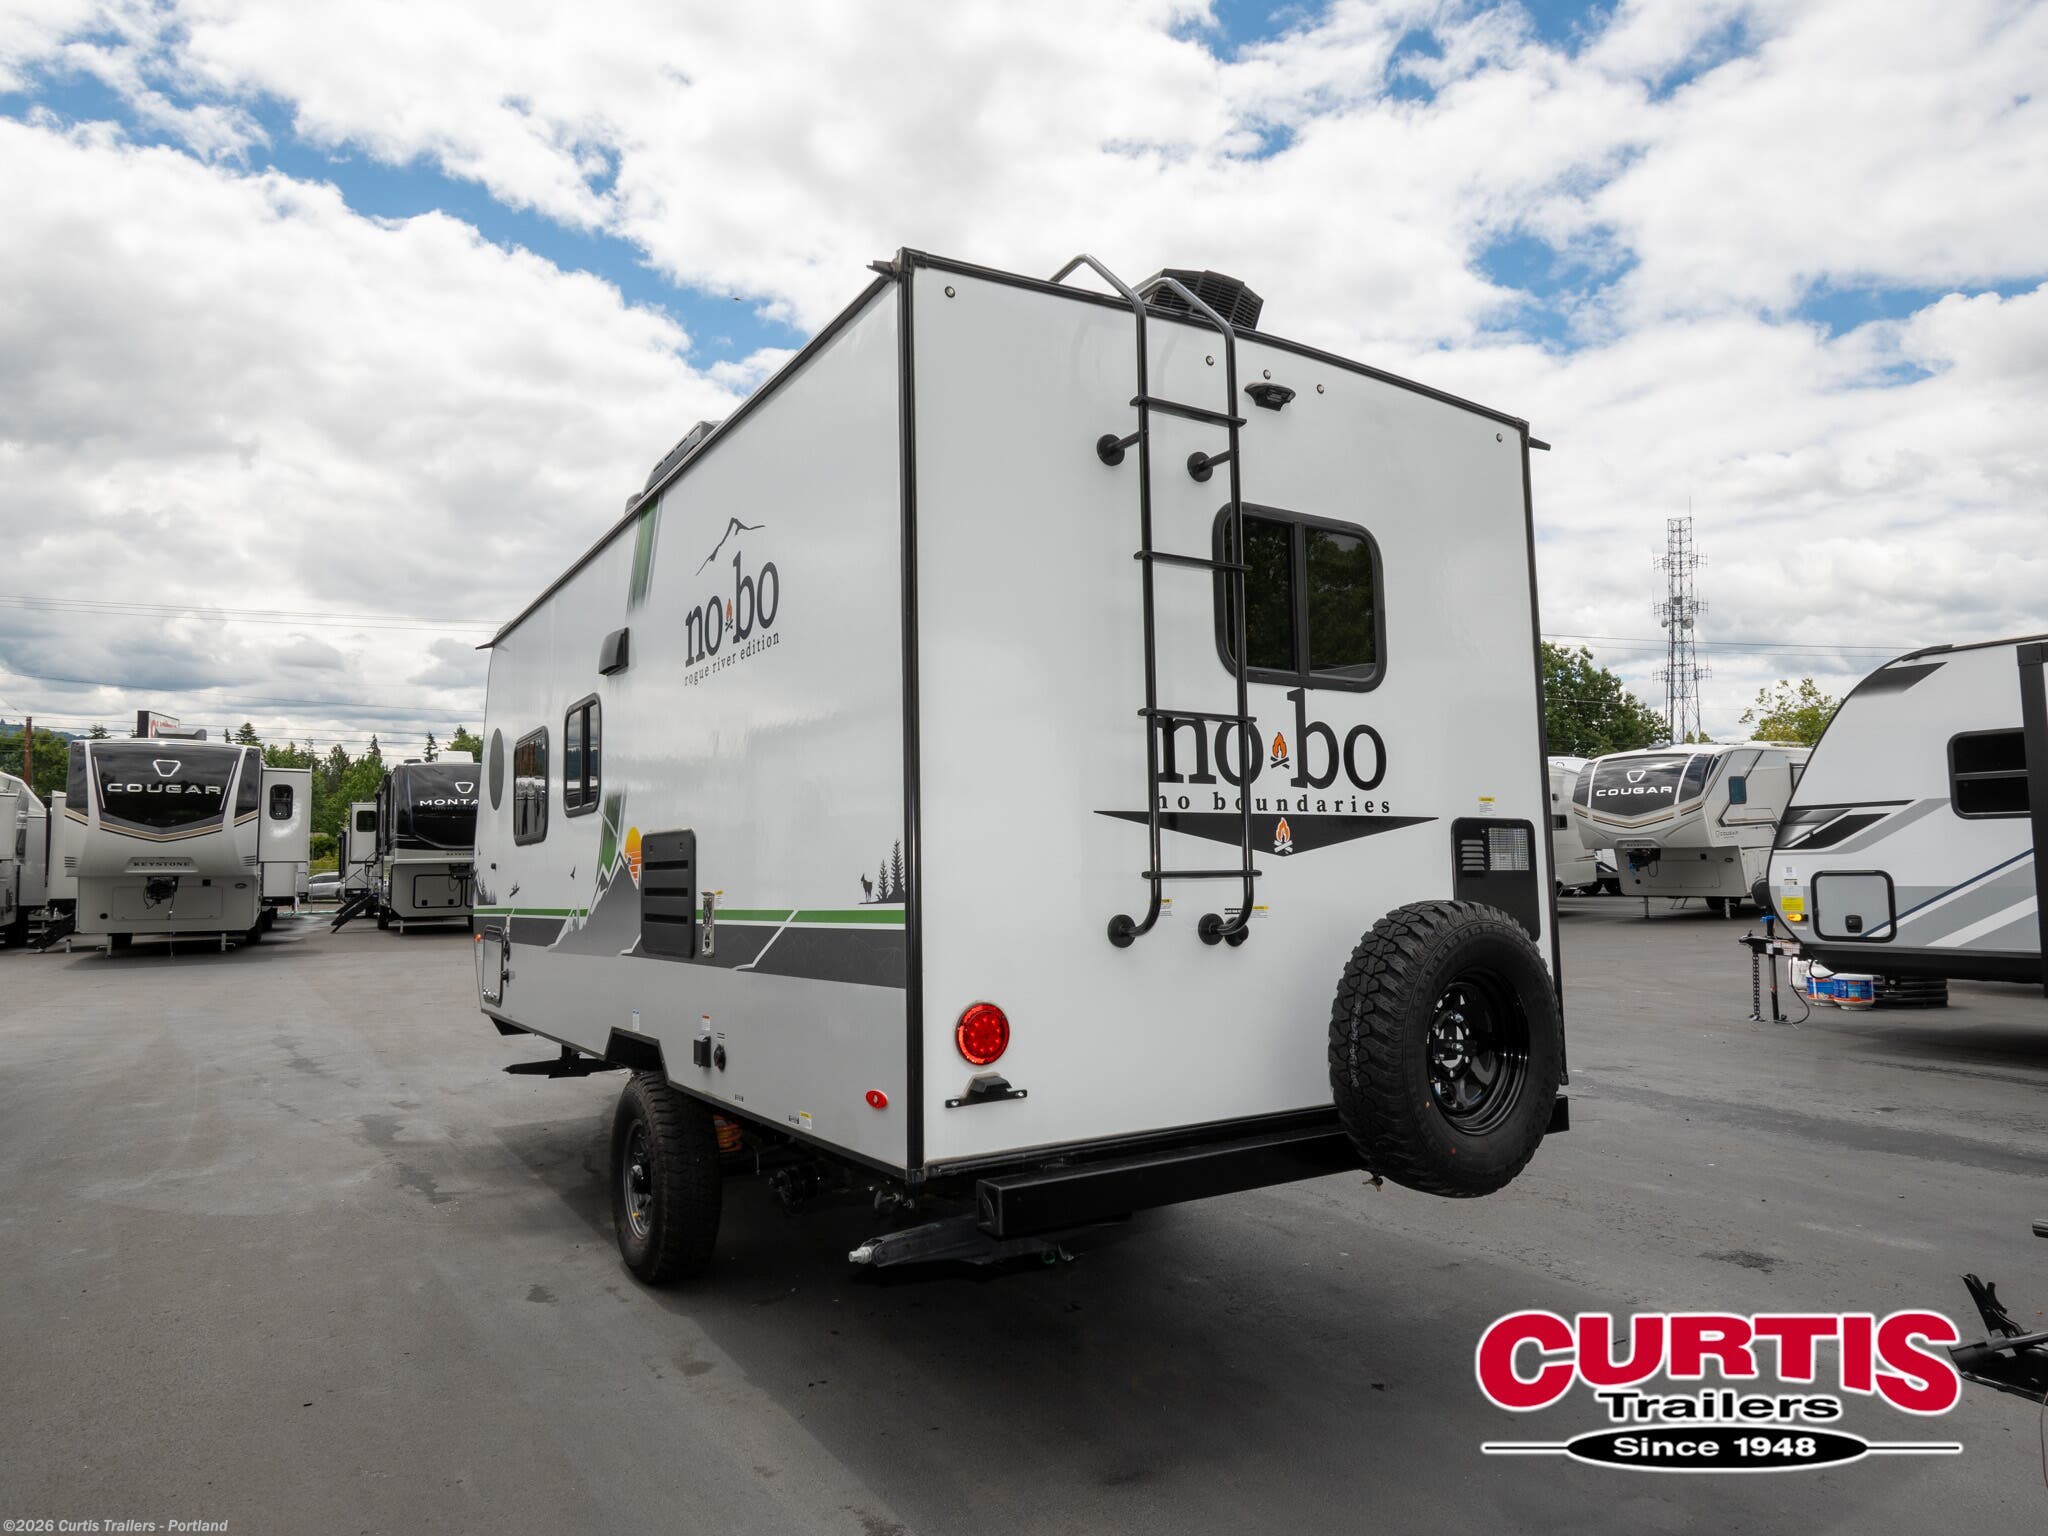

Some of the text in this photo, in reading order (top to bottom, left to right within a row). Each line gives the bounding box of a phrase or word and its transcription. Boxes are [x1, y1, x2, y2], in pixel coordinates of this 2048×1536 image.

[684, 631, 780, 687] rogue river edition
[106, 783, 222, 795] COUGAR
[1596, 785, 1673, 797] COUGAR
